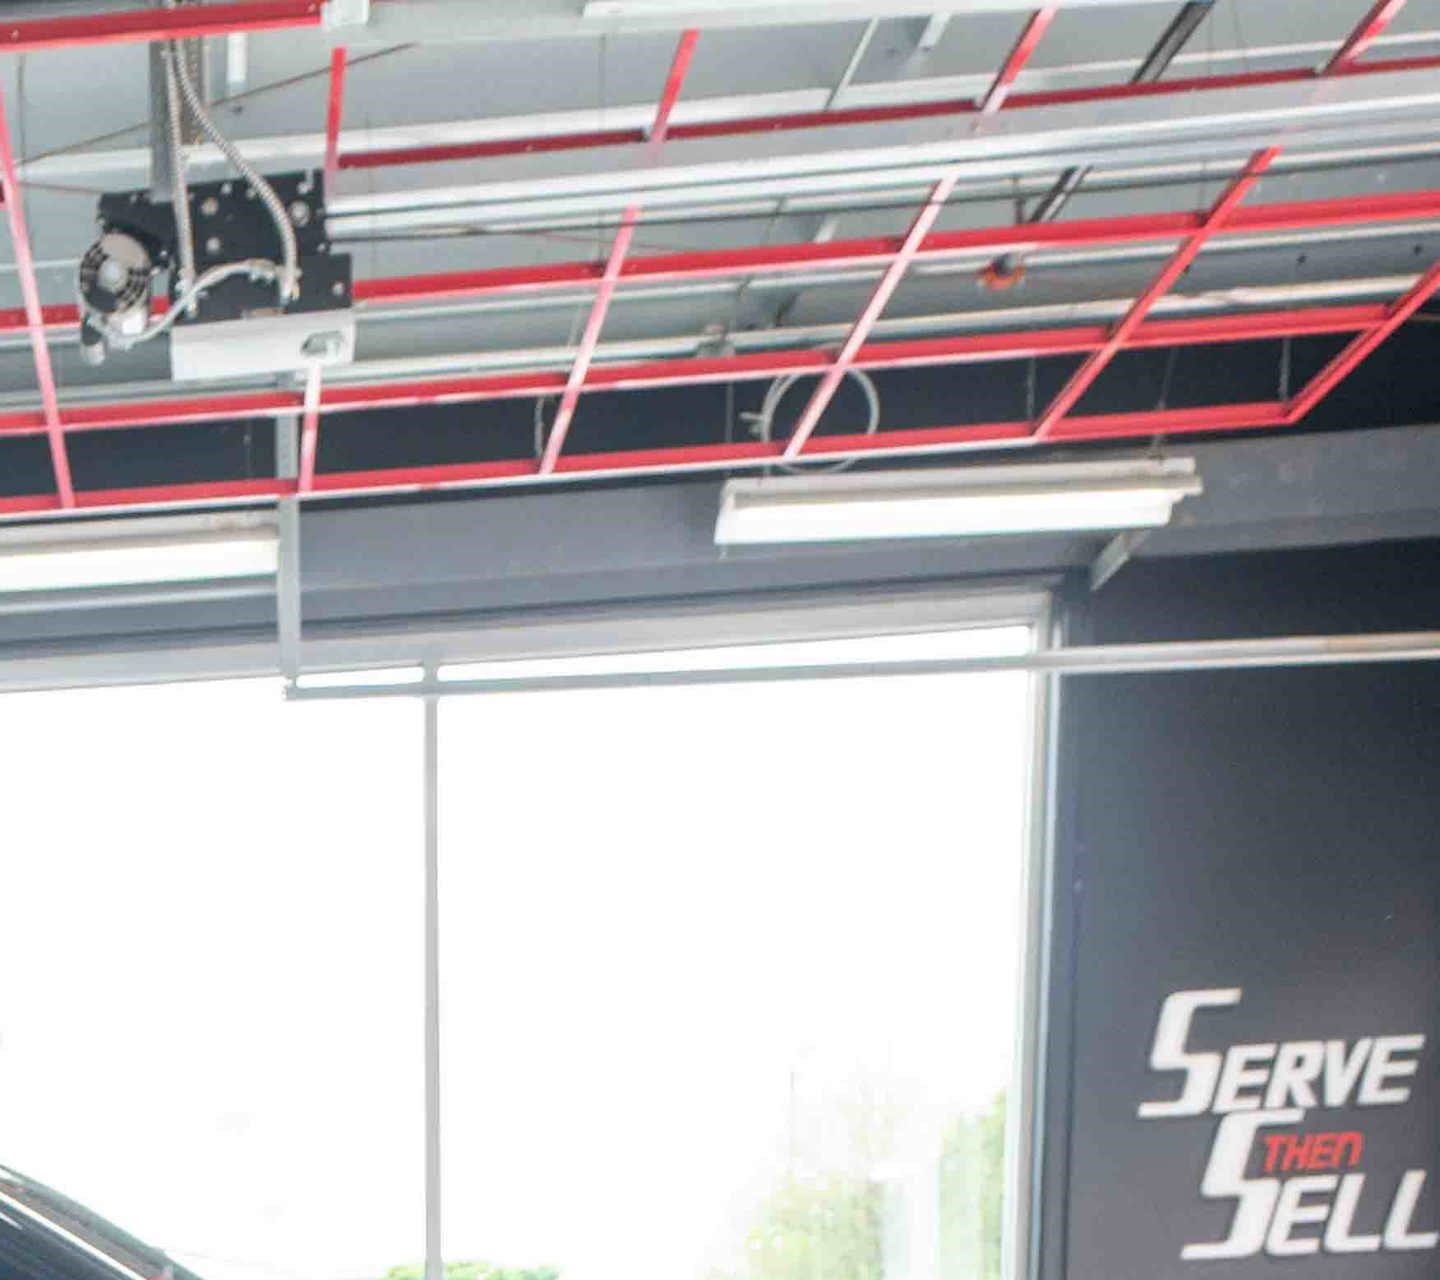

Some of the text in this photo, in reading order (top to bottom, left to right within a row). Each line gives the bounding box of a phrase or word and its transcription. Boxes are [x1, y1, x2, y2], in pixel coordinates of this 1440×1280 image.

[1138, 988, 1426, 1118] SERVE
[1180, 1107, 1440, 1261] SELL
[1263, 1131, 1363, 1173] THEN
